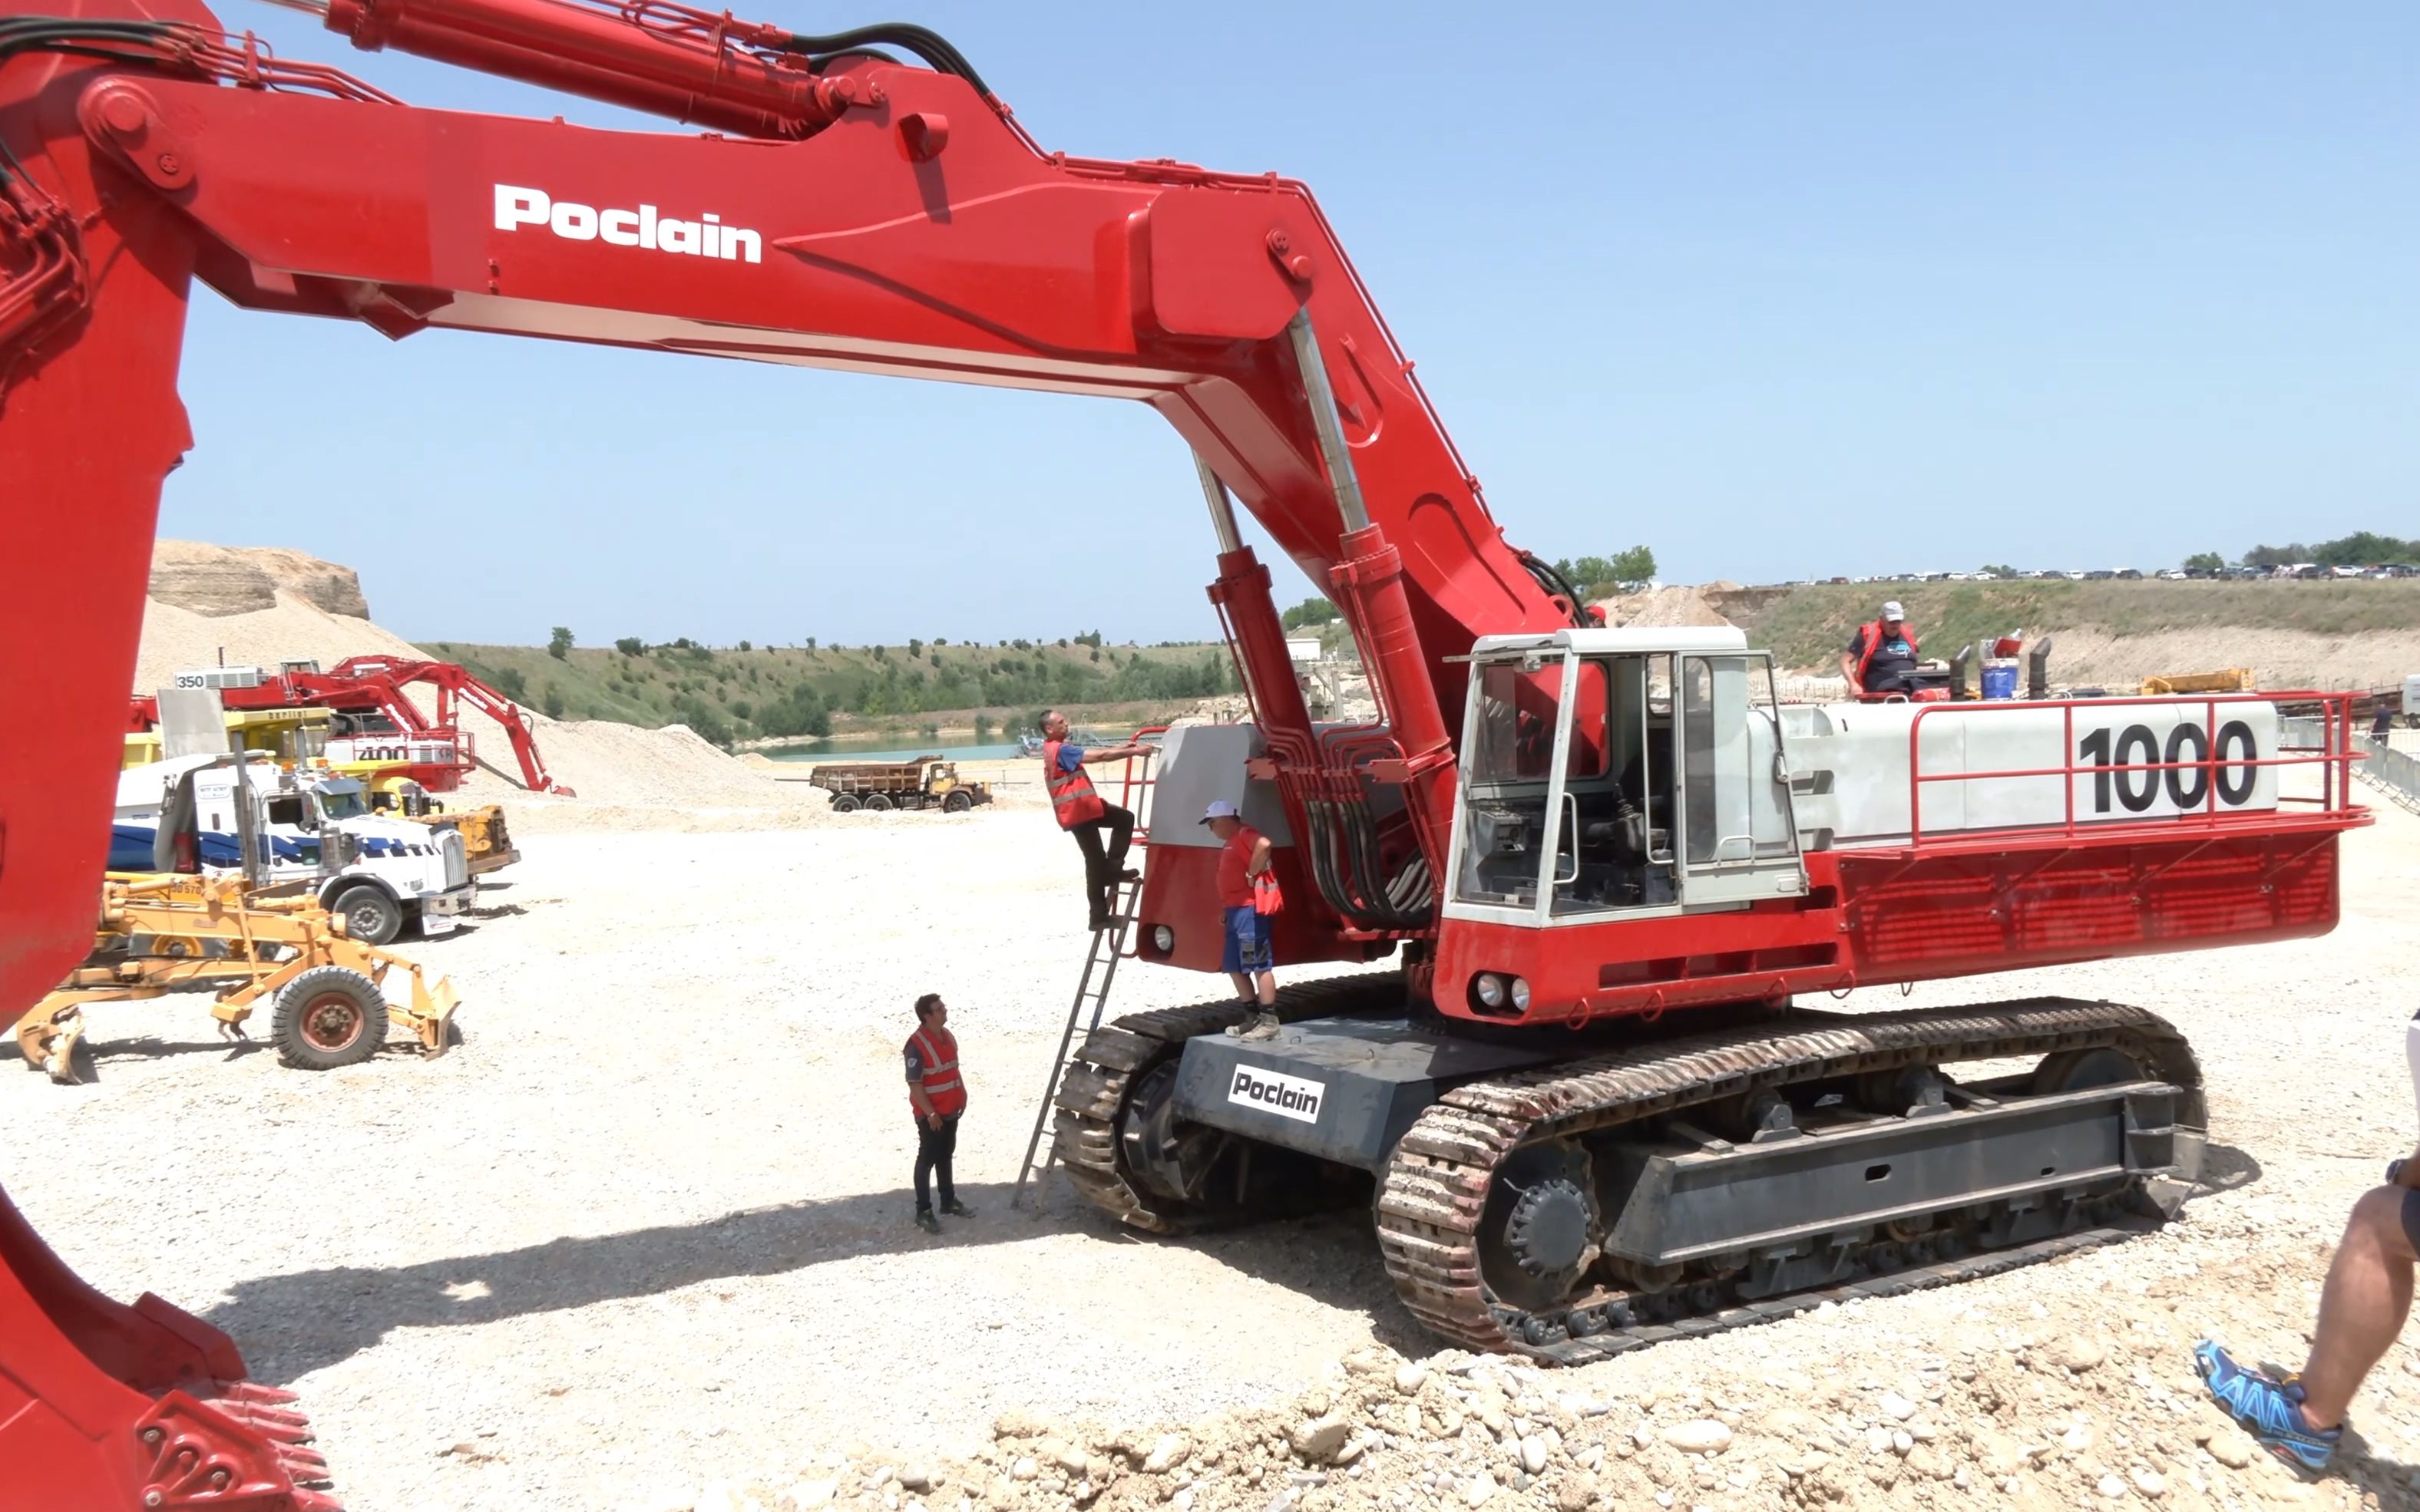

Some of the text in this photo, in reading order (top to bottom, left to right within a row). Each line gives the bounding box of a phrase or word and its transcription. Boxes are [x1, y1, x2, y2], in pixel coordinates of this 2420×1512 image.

[494, 184, 762, 264] Poclain
[177, 676, 204, 688] 350
[359, 746, 409, 761] 400
[2080, 720, 2257, 814] 1000
[185, 886, 201, 894] 570
[1232, 1072, 1318, 1114] Poclain
